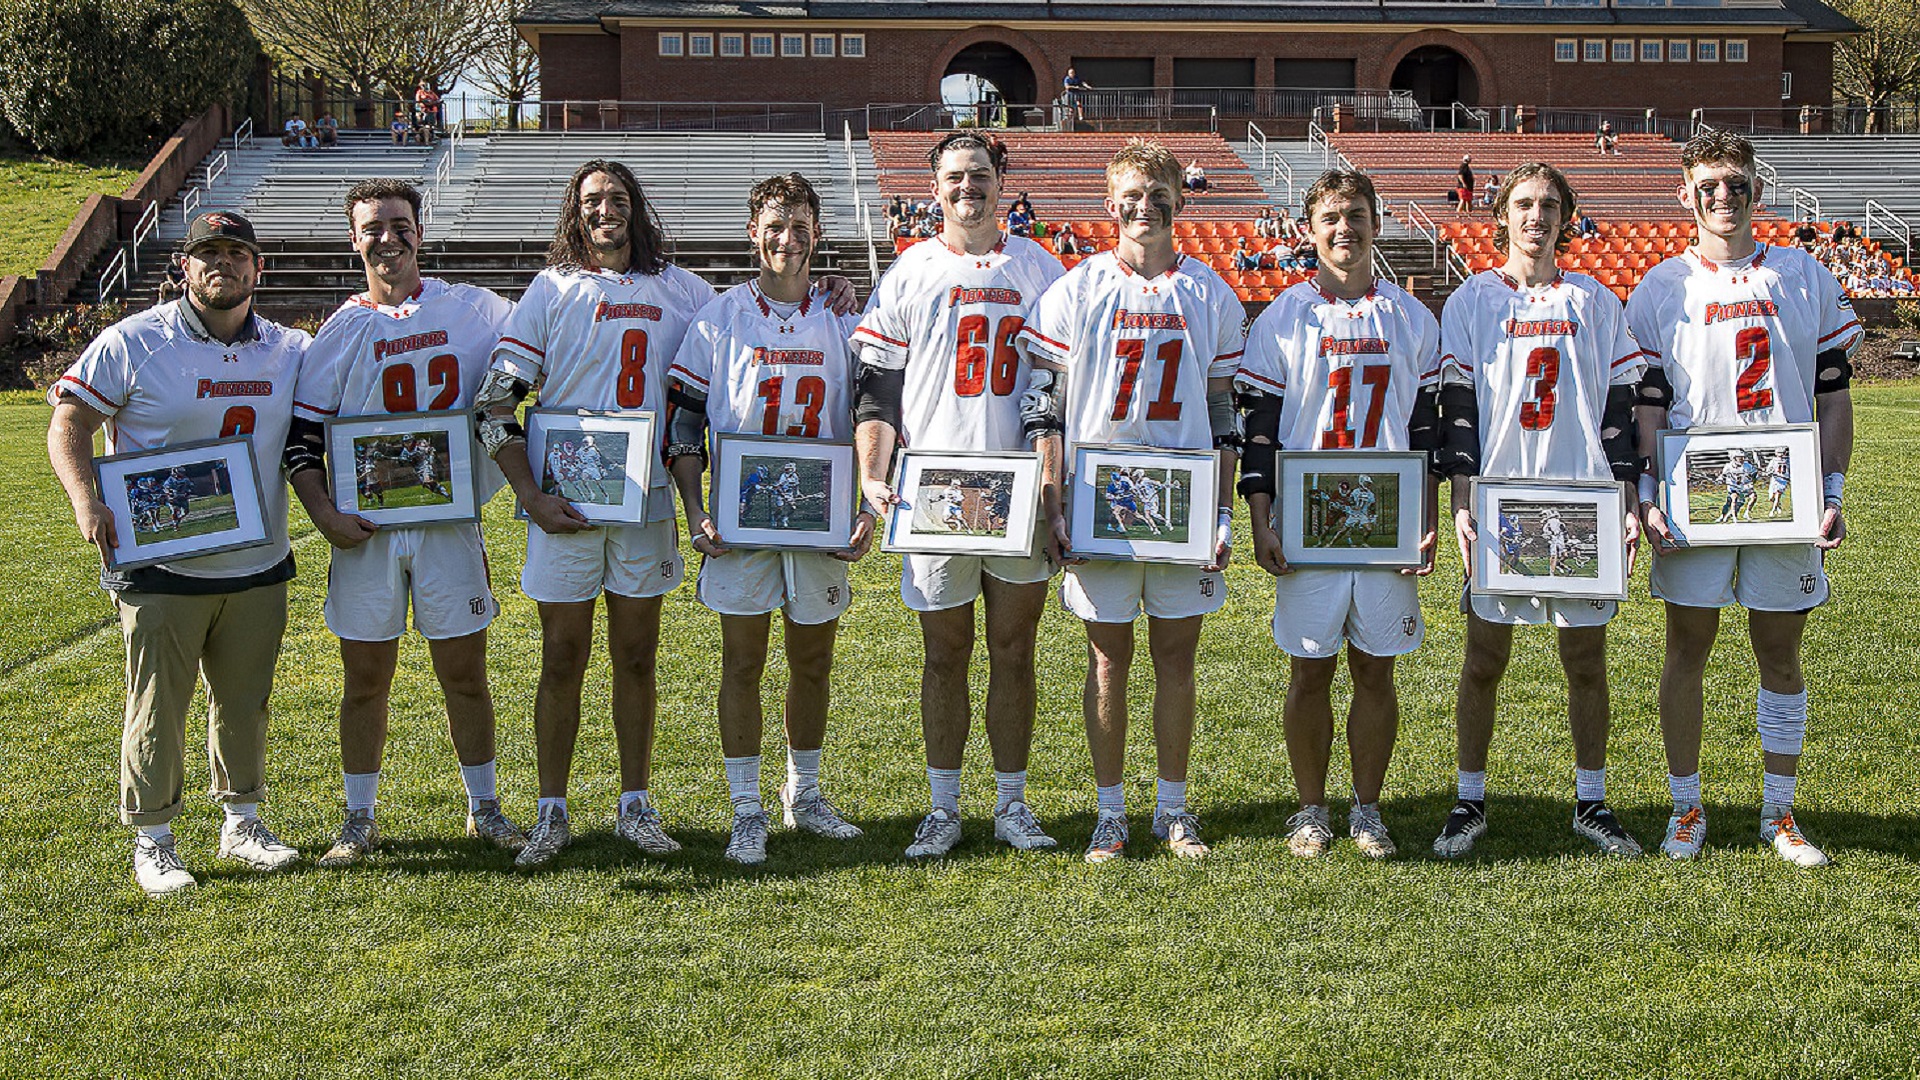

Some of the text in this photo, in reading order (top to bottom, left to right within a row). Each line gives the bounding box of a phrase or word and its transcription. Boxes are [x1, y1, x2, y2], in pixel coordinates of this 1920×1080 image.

[595, 301, 663, 322] PIONEERS
[949, 285, 1023, 308] PIONEERS
[1112, 309, 1187, 330] PIONEERS
[383, 354, 459, 413] 92
[617, 329, 648, 408] 8
[752, 346, 825, 367] PIONEERS
[954, 314, 1026, 397] 66
[1110, 338, 1184, 421] 71
[1735, 326, 1774, 413] 2
[758, 375, 826, 437] 13
[1321, 365, 1391, 450] 17
[1519, 347, 1560, 431] 3
[469, 596, 486, 615] TU
[1800, 573, 1817, 595] TU
